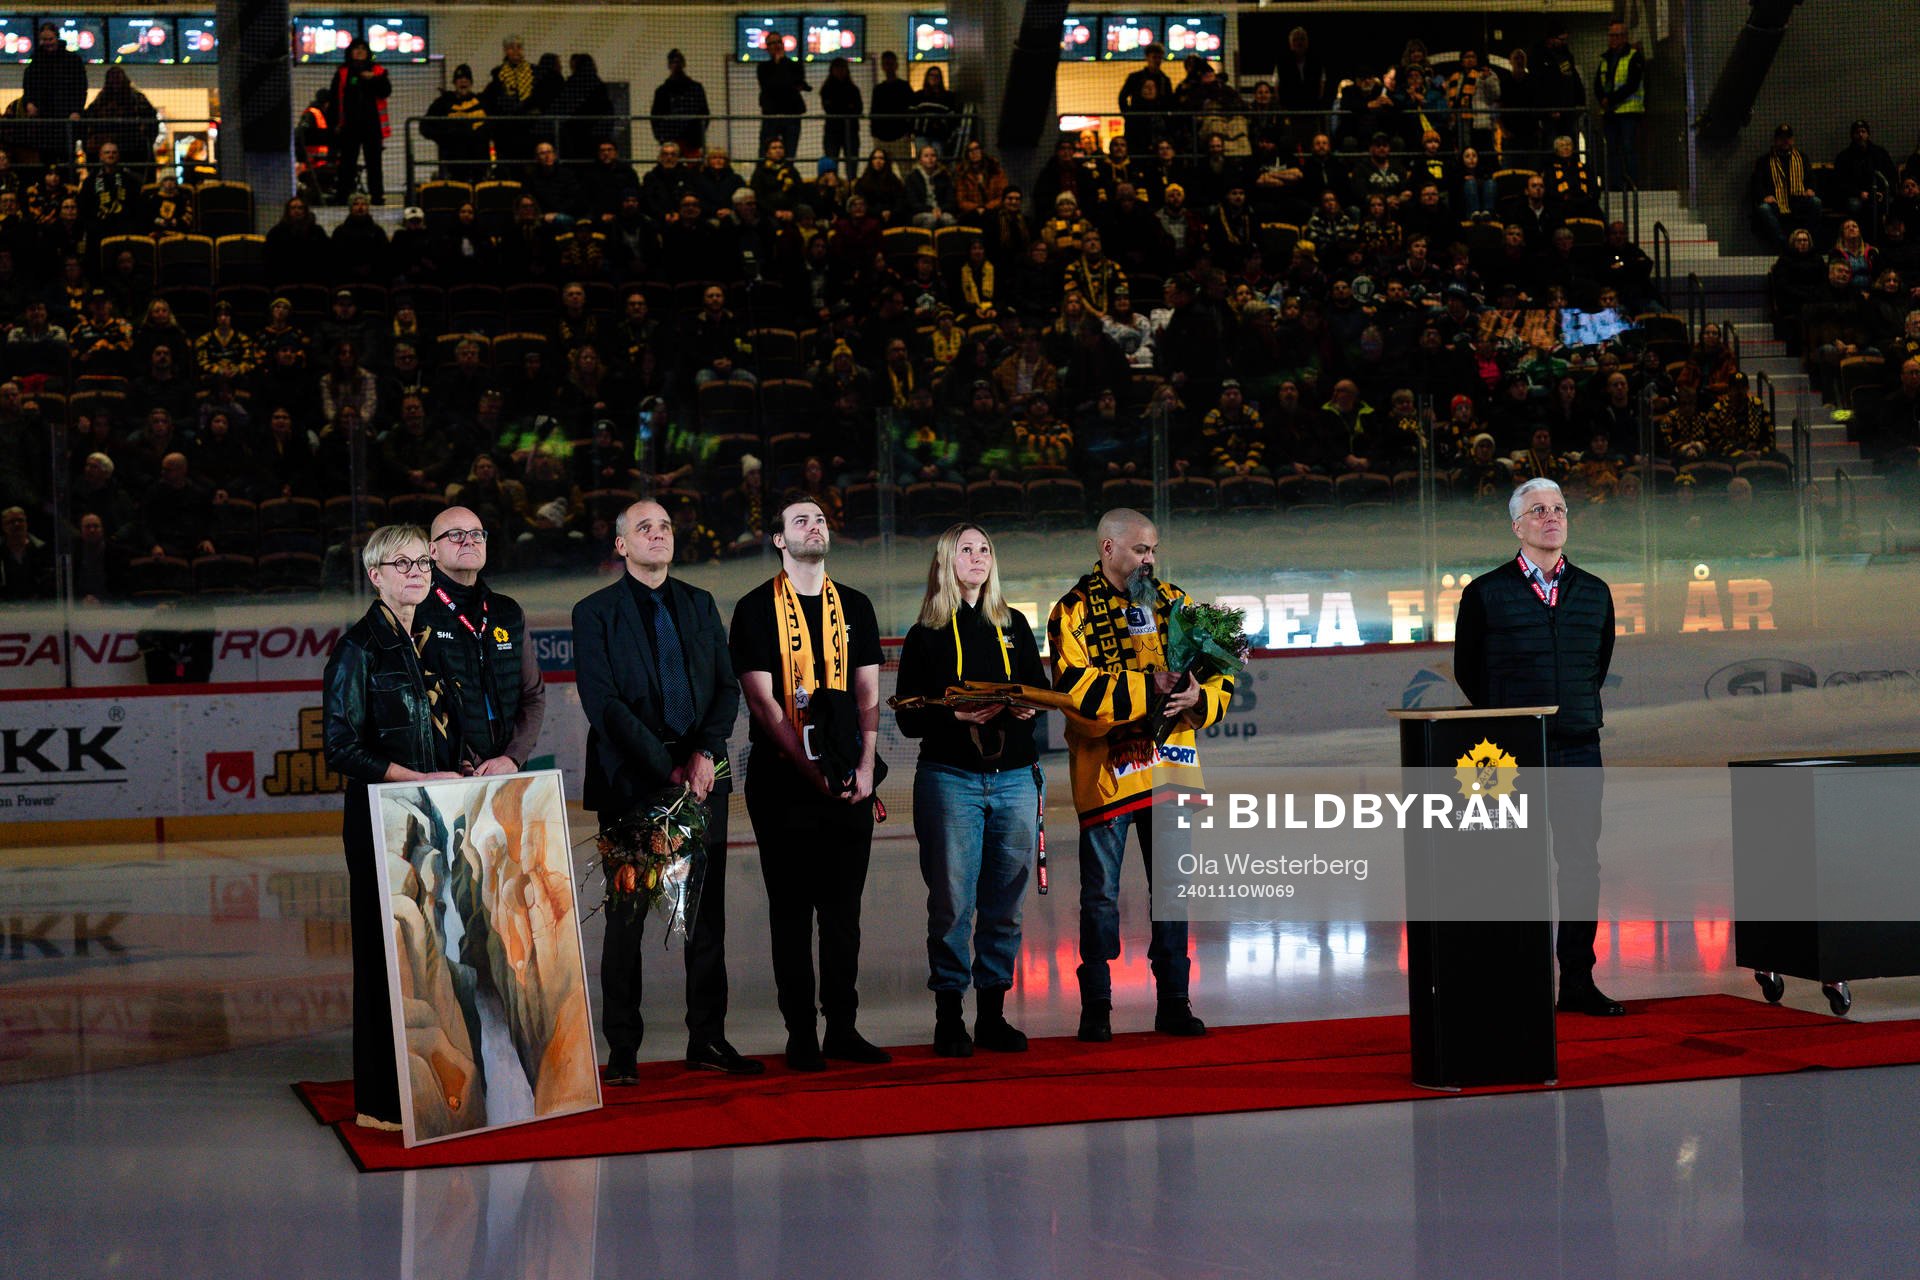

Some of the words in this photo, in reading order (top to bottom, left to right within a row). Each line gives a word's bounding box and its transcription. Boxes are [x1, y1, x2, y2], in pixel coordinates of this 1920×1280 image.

[1388, 574, 1473, 644] FÖ
[1679, 563, 1777, 633] ÅR
[1089, 574, 1123, 674] SKELLEFT
[436, 631, 454, 640] SHL
[1206, 722, 1257, 741] oup
[18, 795, 56, 807] Power
